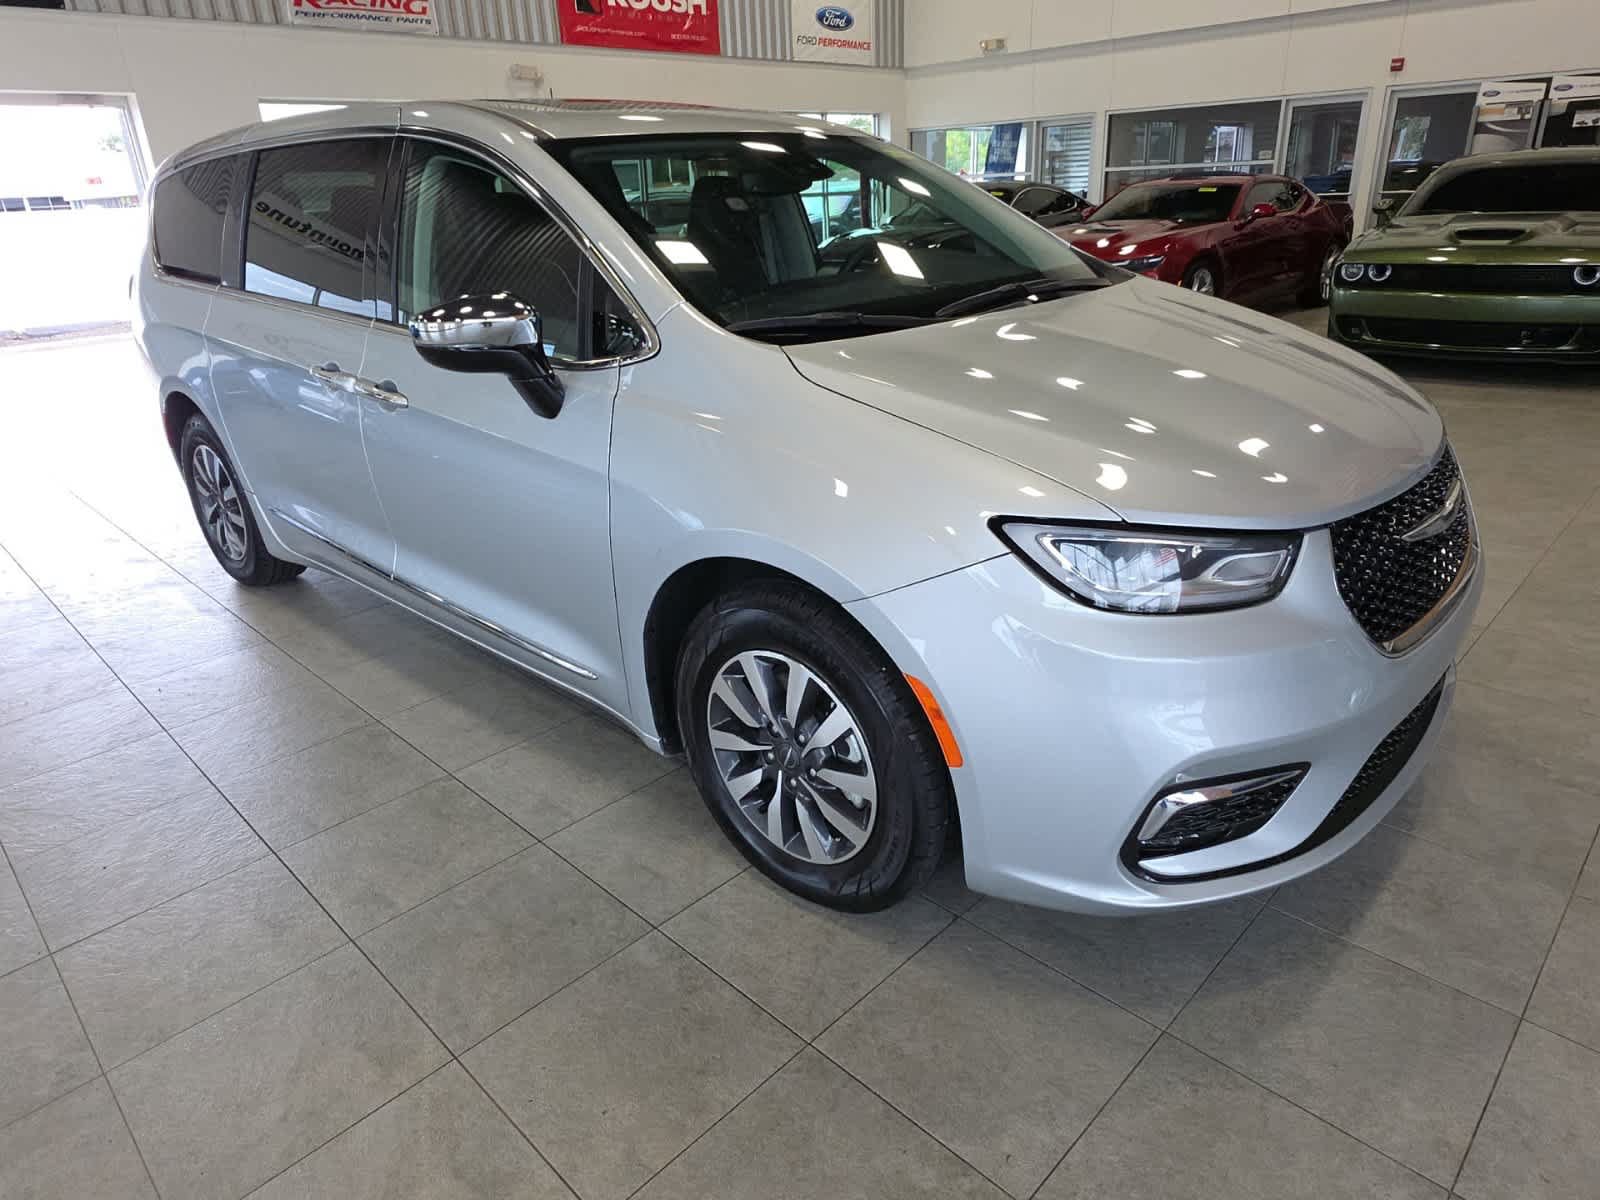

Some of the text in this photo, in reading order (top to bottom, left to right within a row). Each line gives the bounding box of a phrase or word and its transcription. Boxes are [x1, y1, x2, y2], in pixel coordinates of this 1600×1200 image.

[607, 0, 707, 15] USH
[295, 10, 432, 25] PERFORMANCE PARTS
[823, 9, 848, 27] Ford
[796, 35, 871, 51] FORD PERFORMANCE
